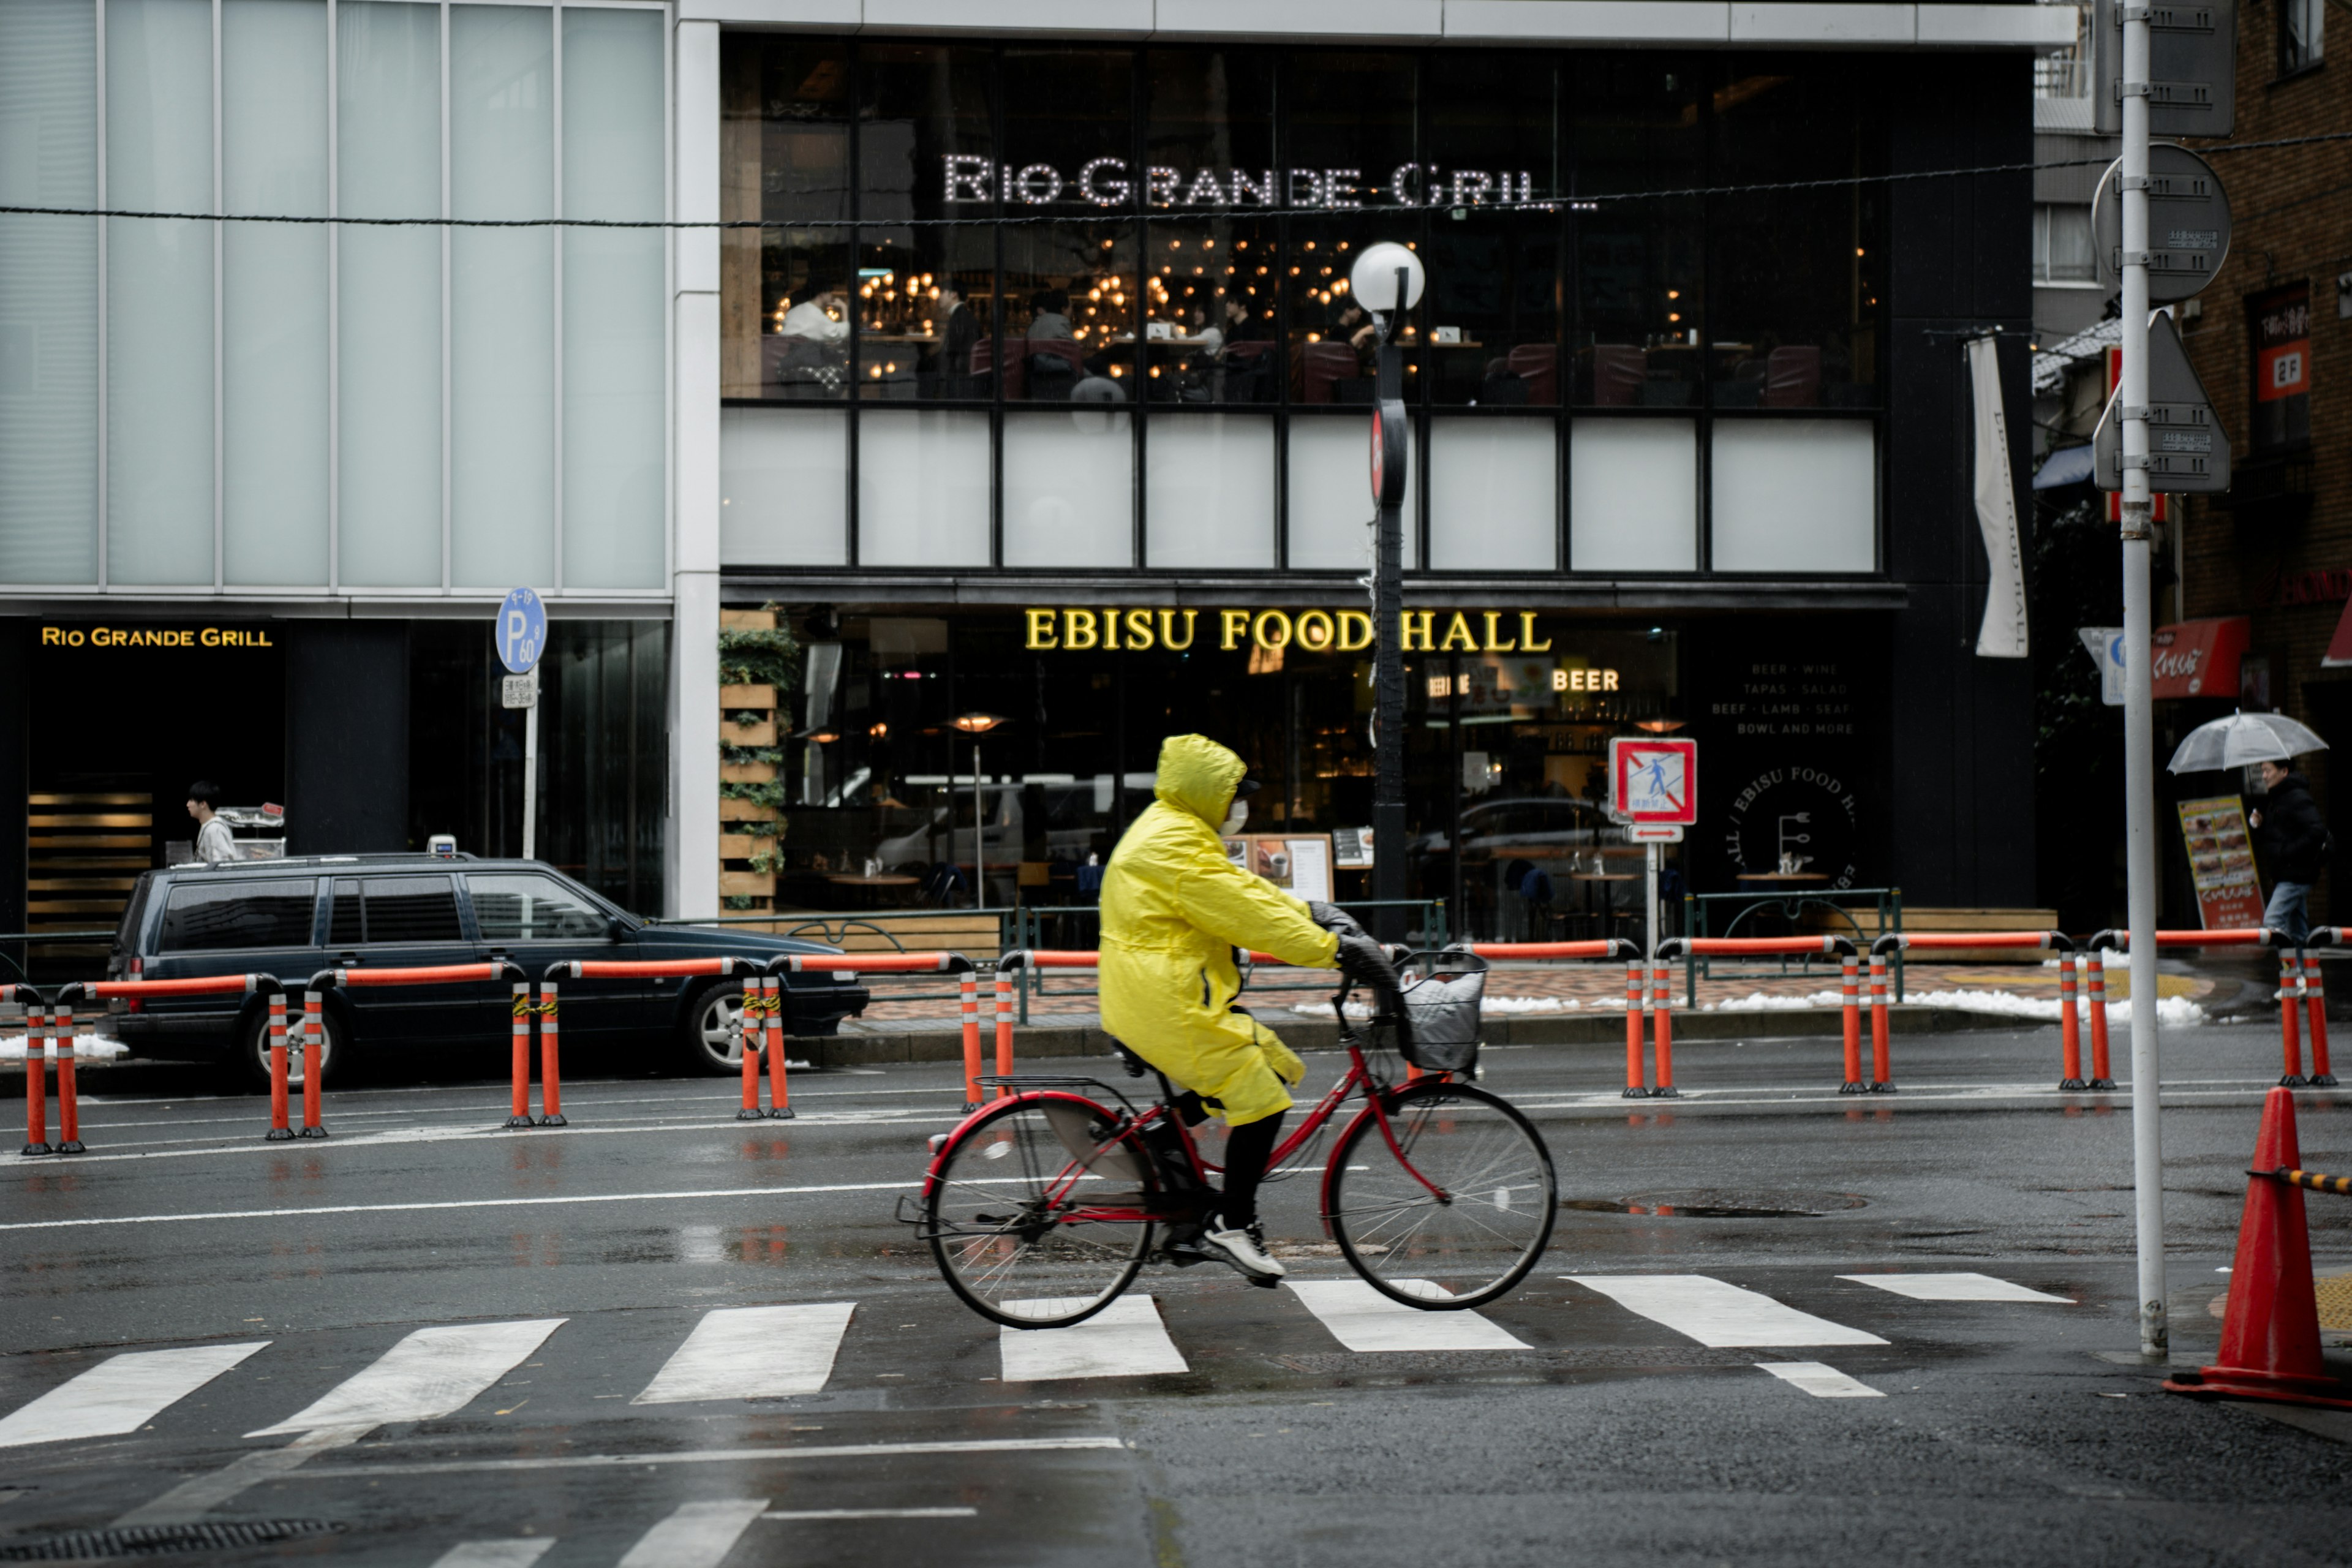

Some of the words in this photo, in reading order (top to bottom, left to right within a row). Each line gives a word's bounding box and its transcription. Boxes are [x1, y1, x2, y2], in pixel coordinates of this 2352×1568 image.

[943, 154, 1063, 205] RIO
[1078, 156, 1361, 209] GRANDE
[1390, 162, 1598, 209] GRIL
[2278, 359, 2297, 383] 2F
[511, 590, 533, 606] 9-19
[2279, 569, 2352, 606] HOND
[2015, 582, 2026, 651] HALL
[42, 627, 85, 647] RIO
[90, 627, 194, 647] GRANDE
[200, 627, 273, 647] GRILL
[506, 610, 527, 664] P
[1025, 608, 1199, 651] EBISU
[1220, 609, 1373, 652] FOOD
[1400, 610, 1553, 653] HALL
[519, 639, 535, 663] 60
[1551, 668, 1619, 692] BEER
[1752, 663, 1788, 676] BEER
[1802, 663, 1838, 676] WINE
[1743, 684, 1787, 695] TAPAS
[1801, 684, 1847, 695] SALAD
[1711, 703, 1747, 715] BEEF
[1762, 703, 1801, 715] LAMB
[1815, 703, 1855, 715] SEAF
[1737, 723, 1776, 735] BOWL
[1781, 723, 1810, 735] AND
[1815, 723, 1854, 735] MORE
[1733, 768, 1784, 813] EBISU
[1790, 766, 1842, 794] FOOD
[1632, 799, 1669, 810] 横断禁止
